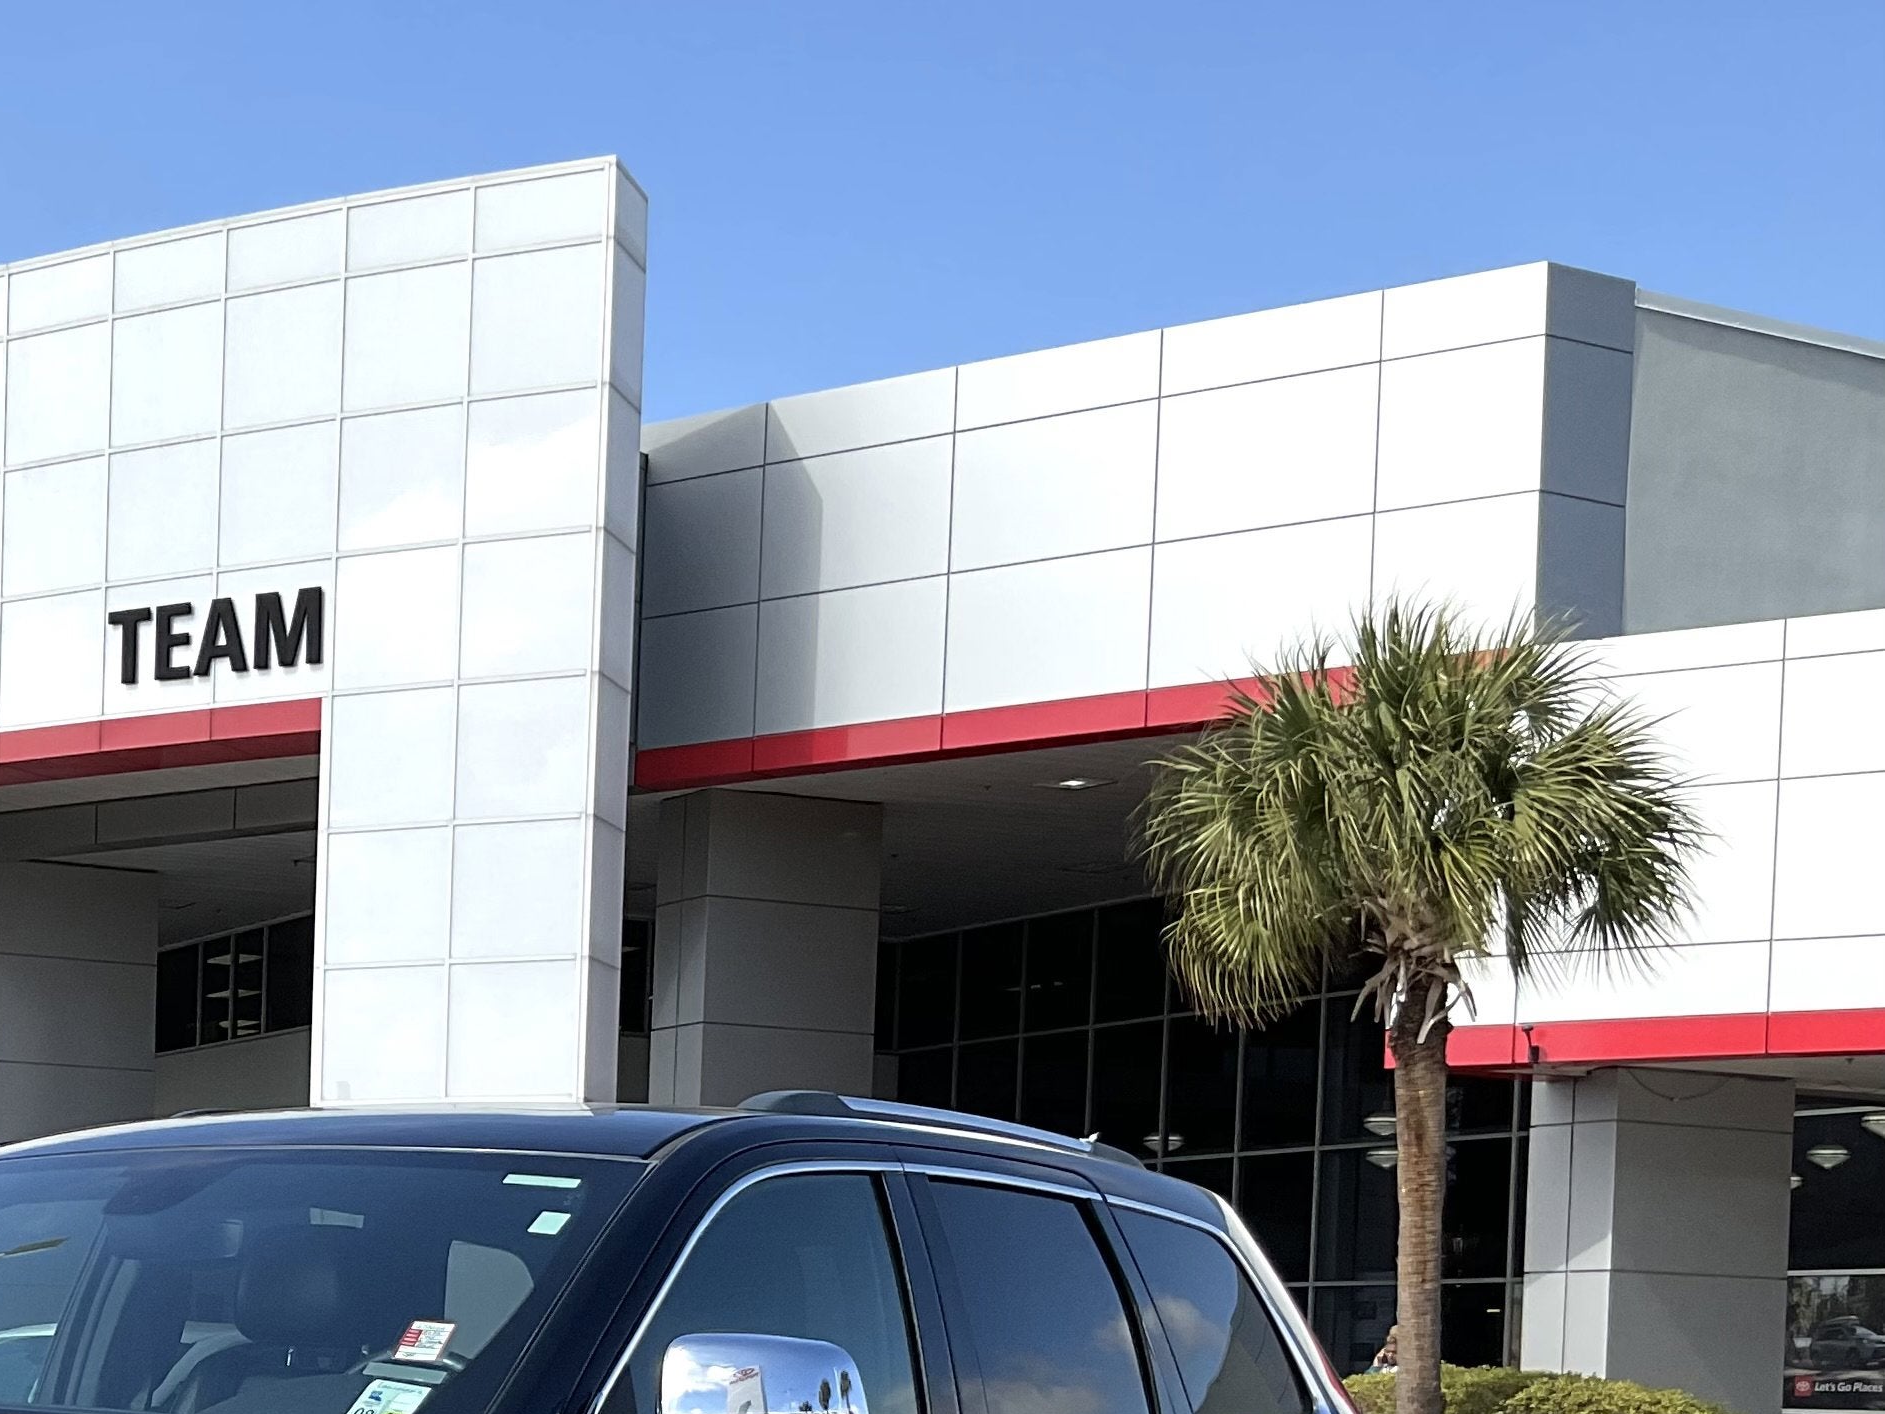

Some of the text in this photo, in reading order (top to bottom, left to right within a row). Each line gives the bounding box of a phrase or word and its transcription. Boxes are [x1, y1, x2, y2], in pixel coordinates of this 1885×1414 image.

[108, 585, 325, 684] TEAM
[1814, 1382, 1883, 1393] Let's Go Places
